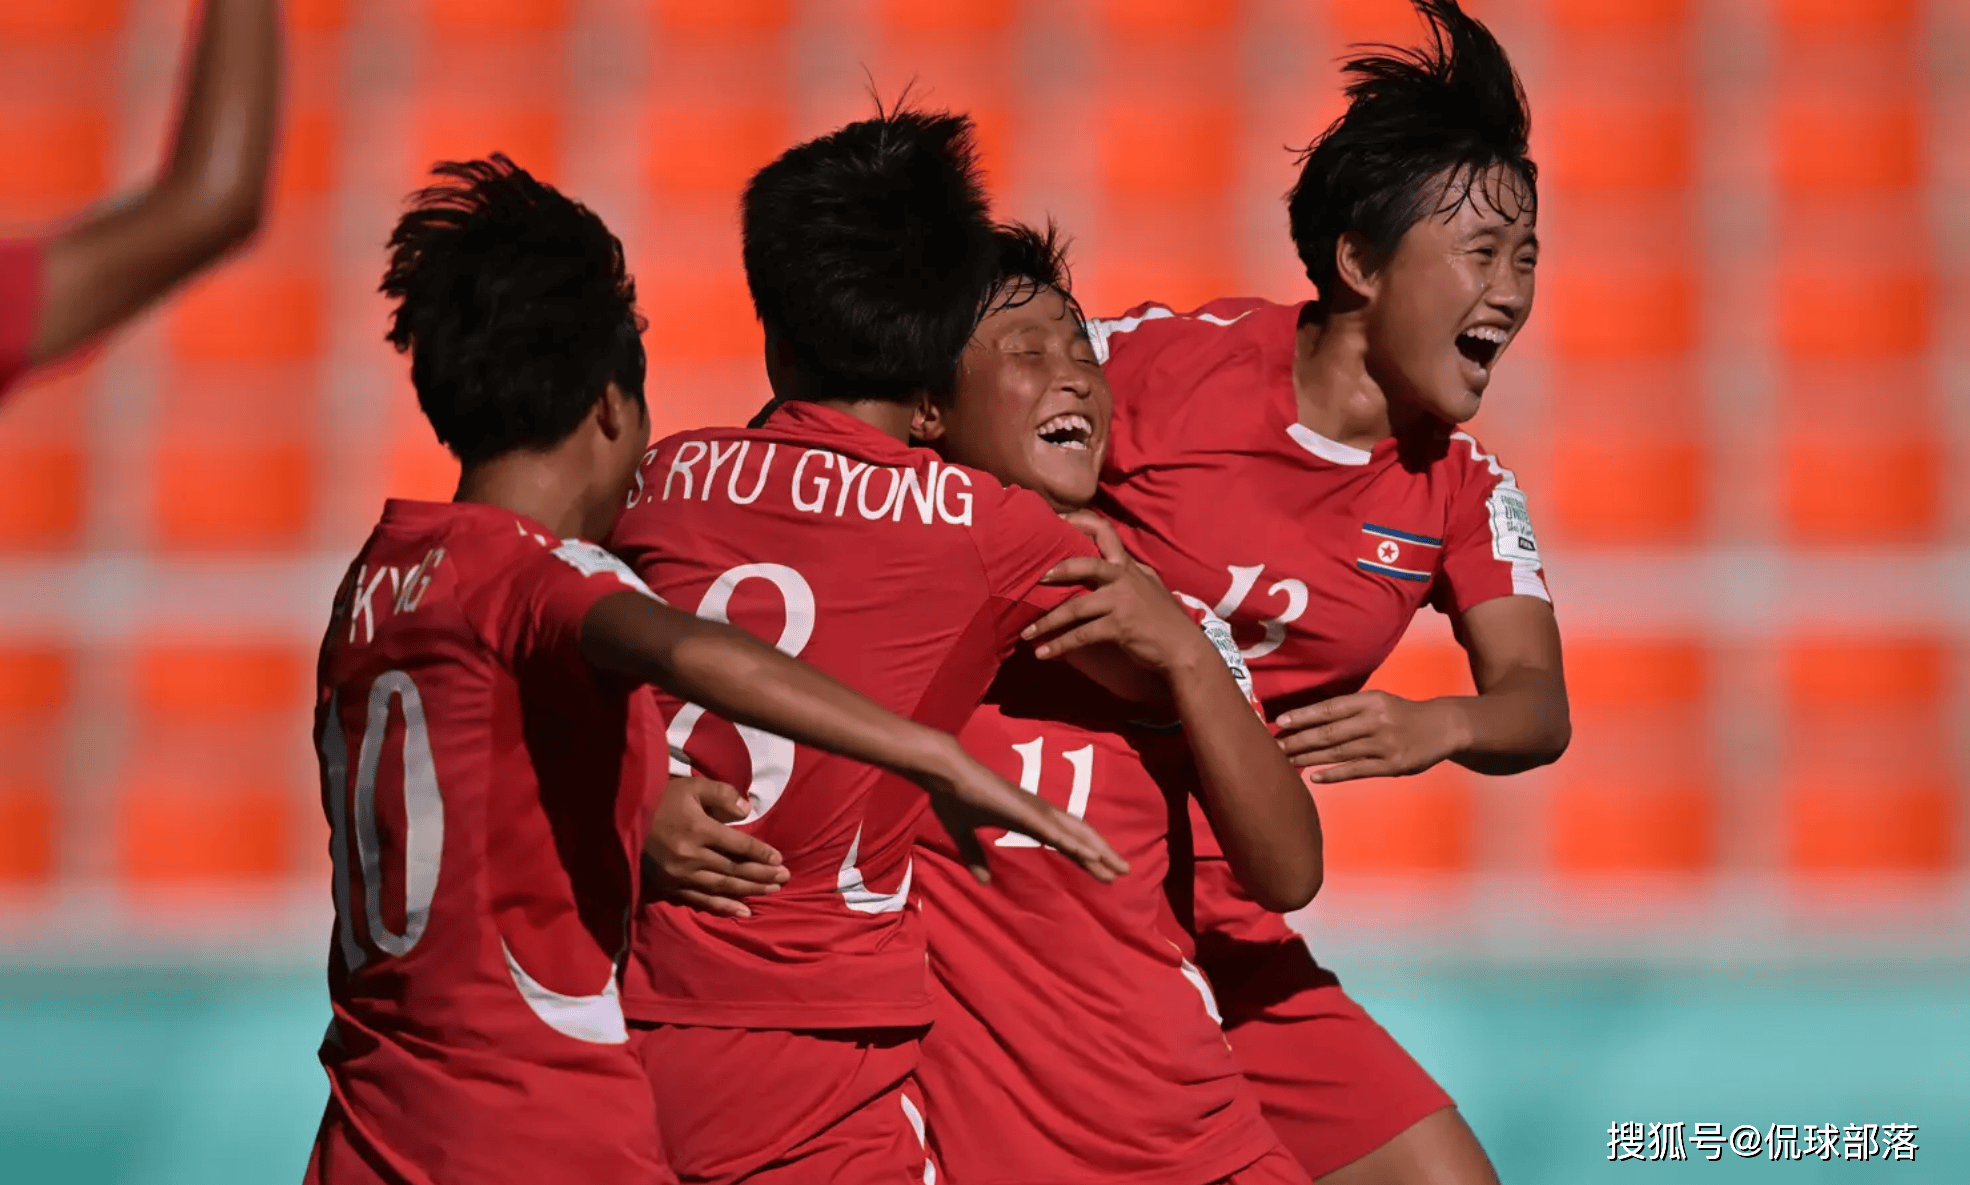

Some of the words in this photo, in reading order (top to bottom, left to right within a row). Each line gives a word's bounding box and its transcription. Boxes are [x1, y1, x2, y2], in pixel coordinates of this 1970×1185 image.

[791, 448, 973, 527] GYONG
[1213, 563, 1309, 659] 13
[666, 562, 816, 826] 8
[322, 669, 444, 965] 10
[994, 736, 1094, 851] 11
